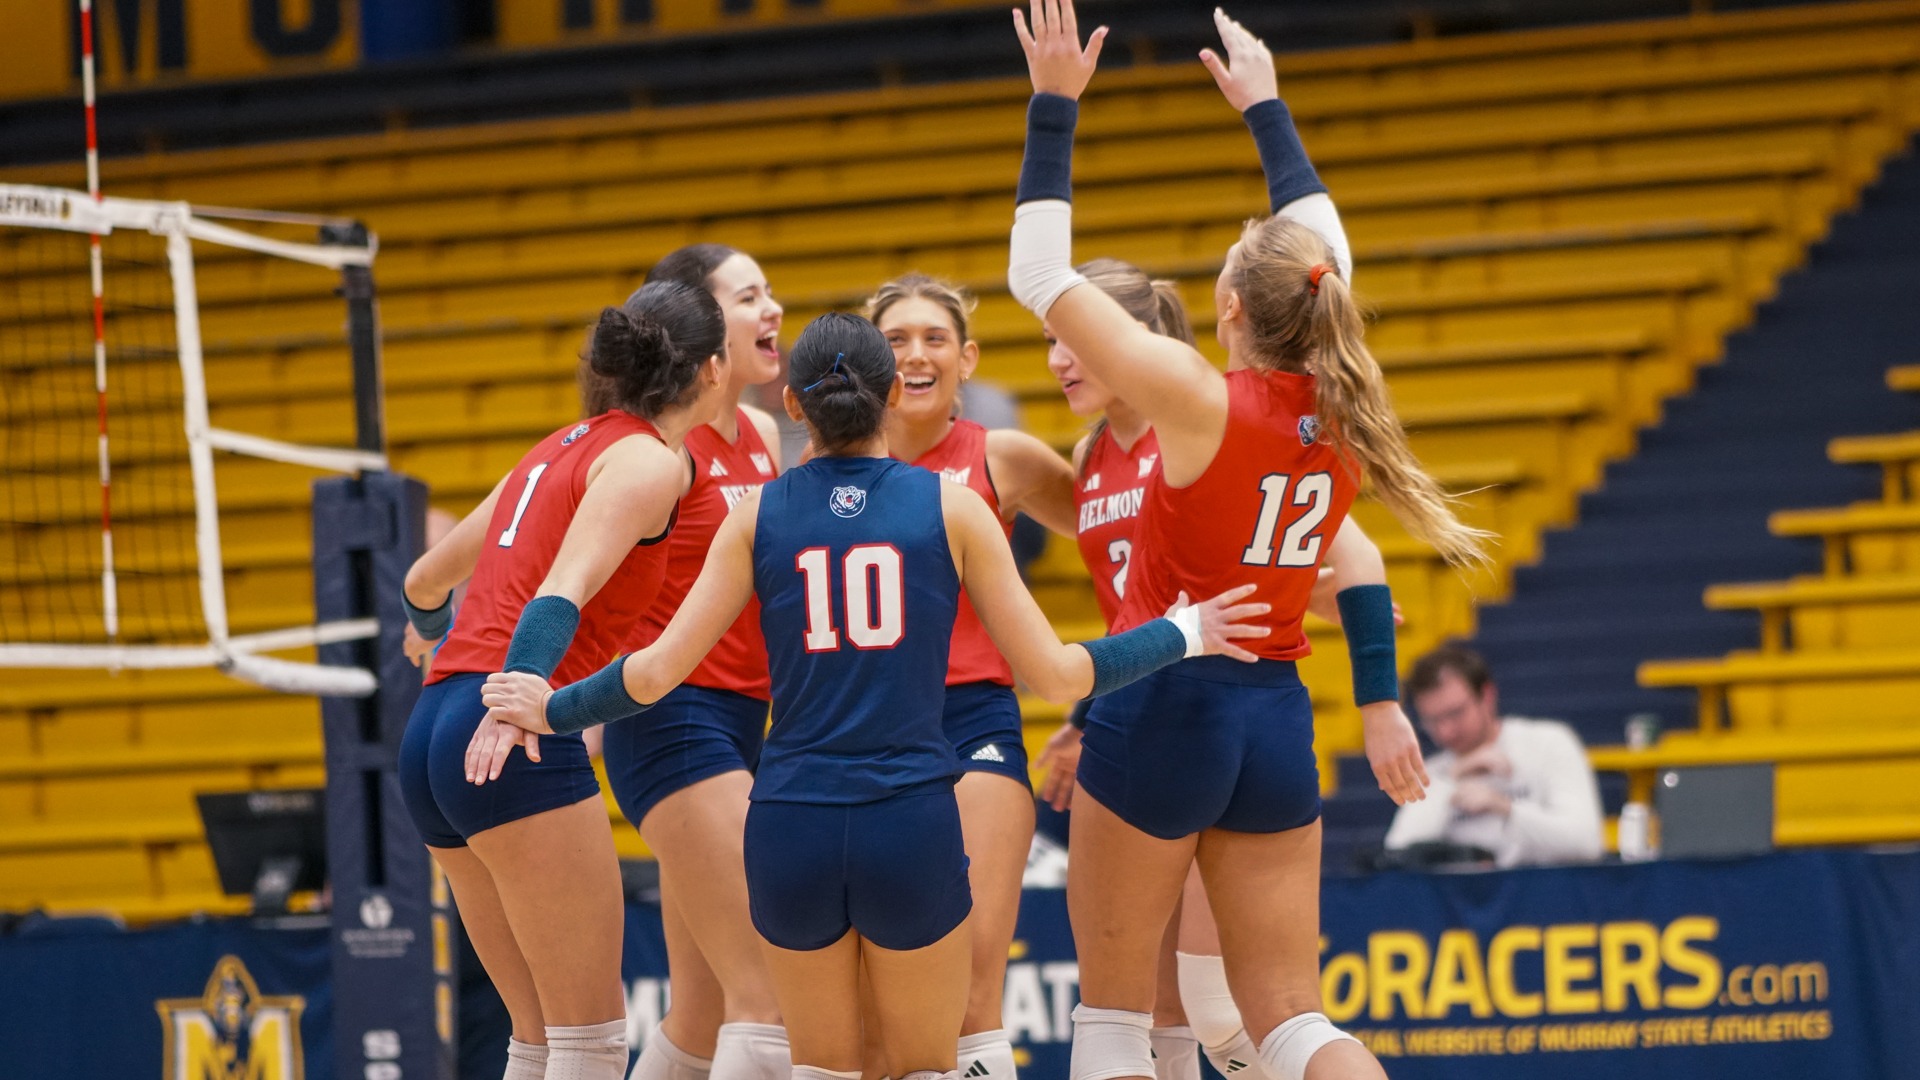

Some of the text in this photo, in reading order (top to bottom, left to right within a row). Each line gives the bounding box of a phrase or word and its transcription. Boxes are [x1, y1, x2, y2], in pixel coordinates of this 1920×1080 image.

[498, 461, 551, 548] 1
[1240, 469, 1334, 568] 12
[795, 542, 906, 654] 10
[1404, 1026, 1506, 1056] WEBSITE
[1506, 1025, 1537, 1054] OF
[1538, 1021, 1638, 1052] MURRAY
[1639, 1015, 1710, 1048] STATE
[1709, 1010, 1833, 1043] ATHLETICS
